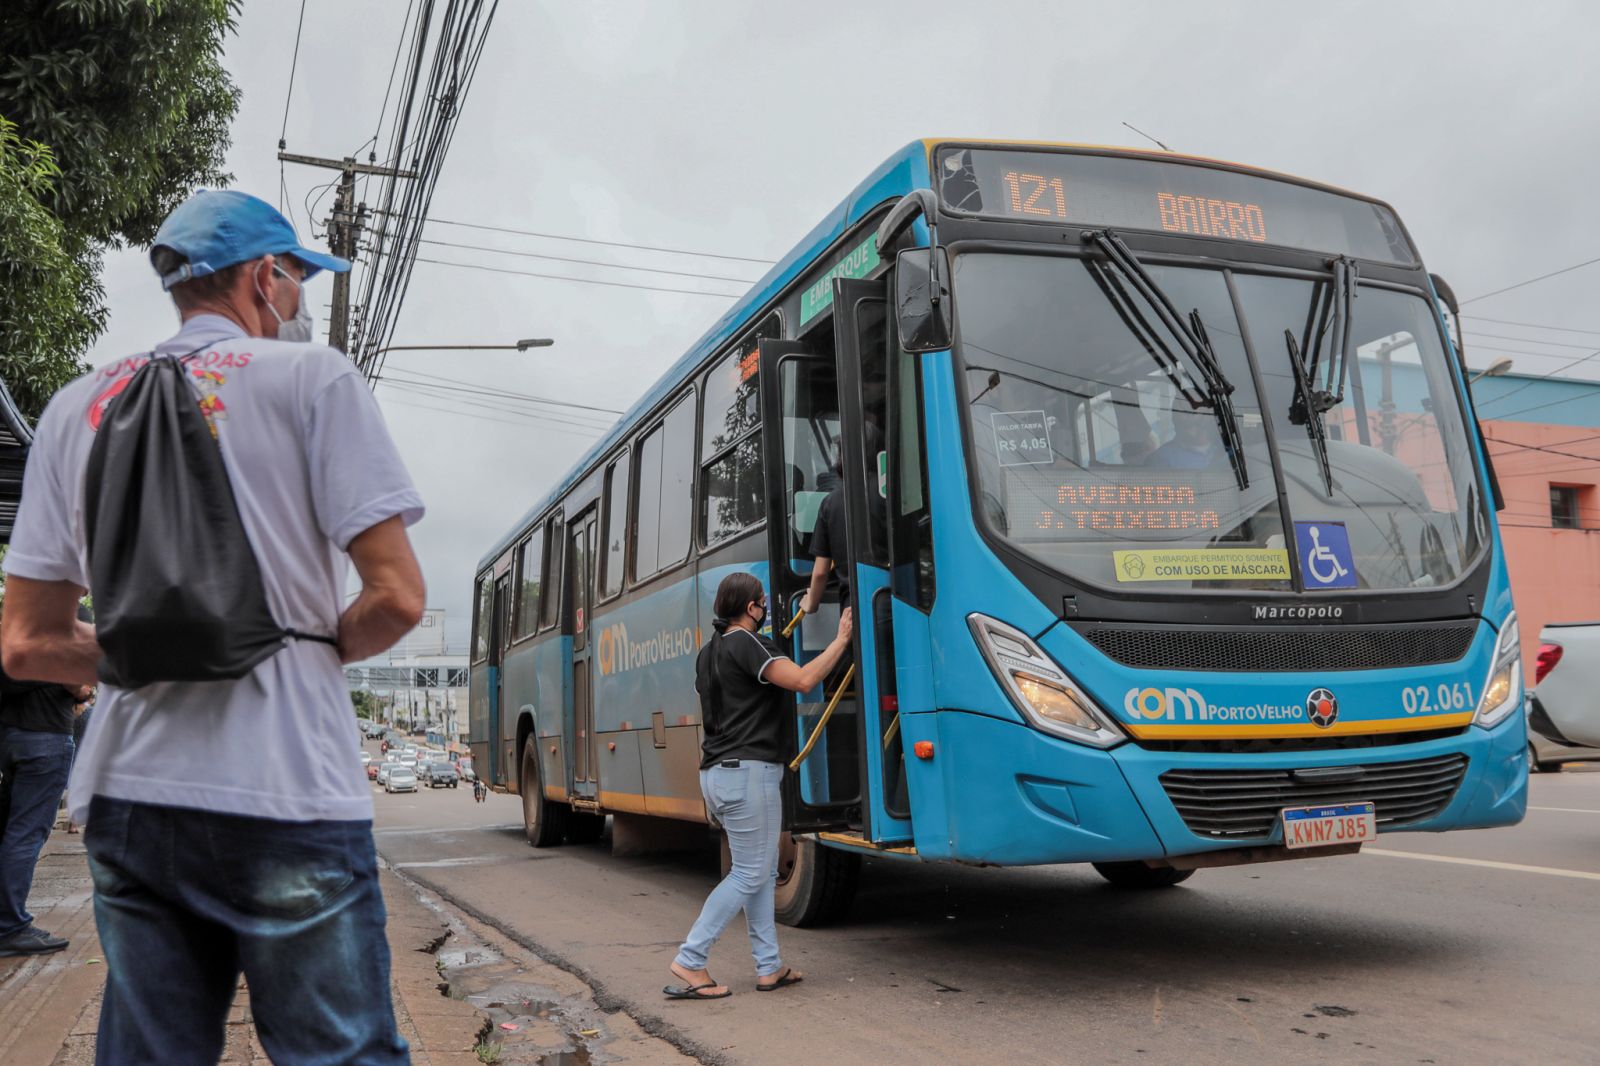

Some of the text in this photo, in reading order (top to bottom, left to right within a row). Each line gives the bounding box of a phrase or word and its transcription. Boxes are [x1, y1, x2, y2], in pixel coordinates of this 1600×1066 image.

[1004, 171, 1267, 242] 121 BAIRRO
[999, 437, 1047, 452] R$ 4,05
[1057, 485, 1195, 504] AVENIDA
[1153, 553, 1282, 563] EMBARQUE PERMITIDO SOMENTE
[1155, 563, 1286, 576] COM USO DE MÁSCARA
[1255, 605, 1343, 619] Marcopolo
[1401, 681, 1475, 714] 02.061
[1292, 816, 1367, 844] KWN7J85
